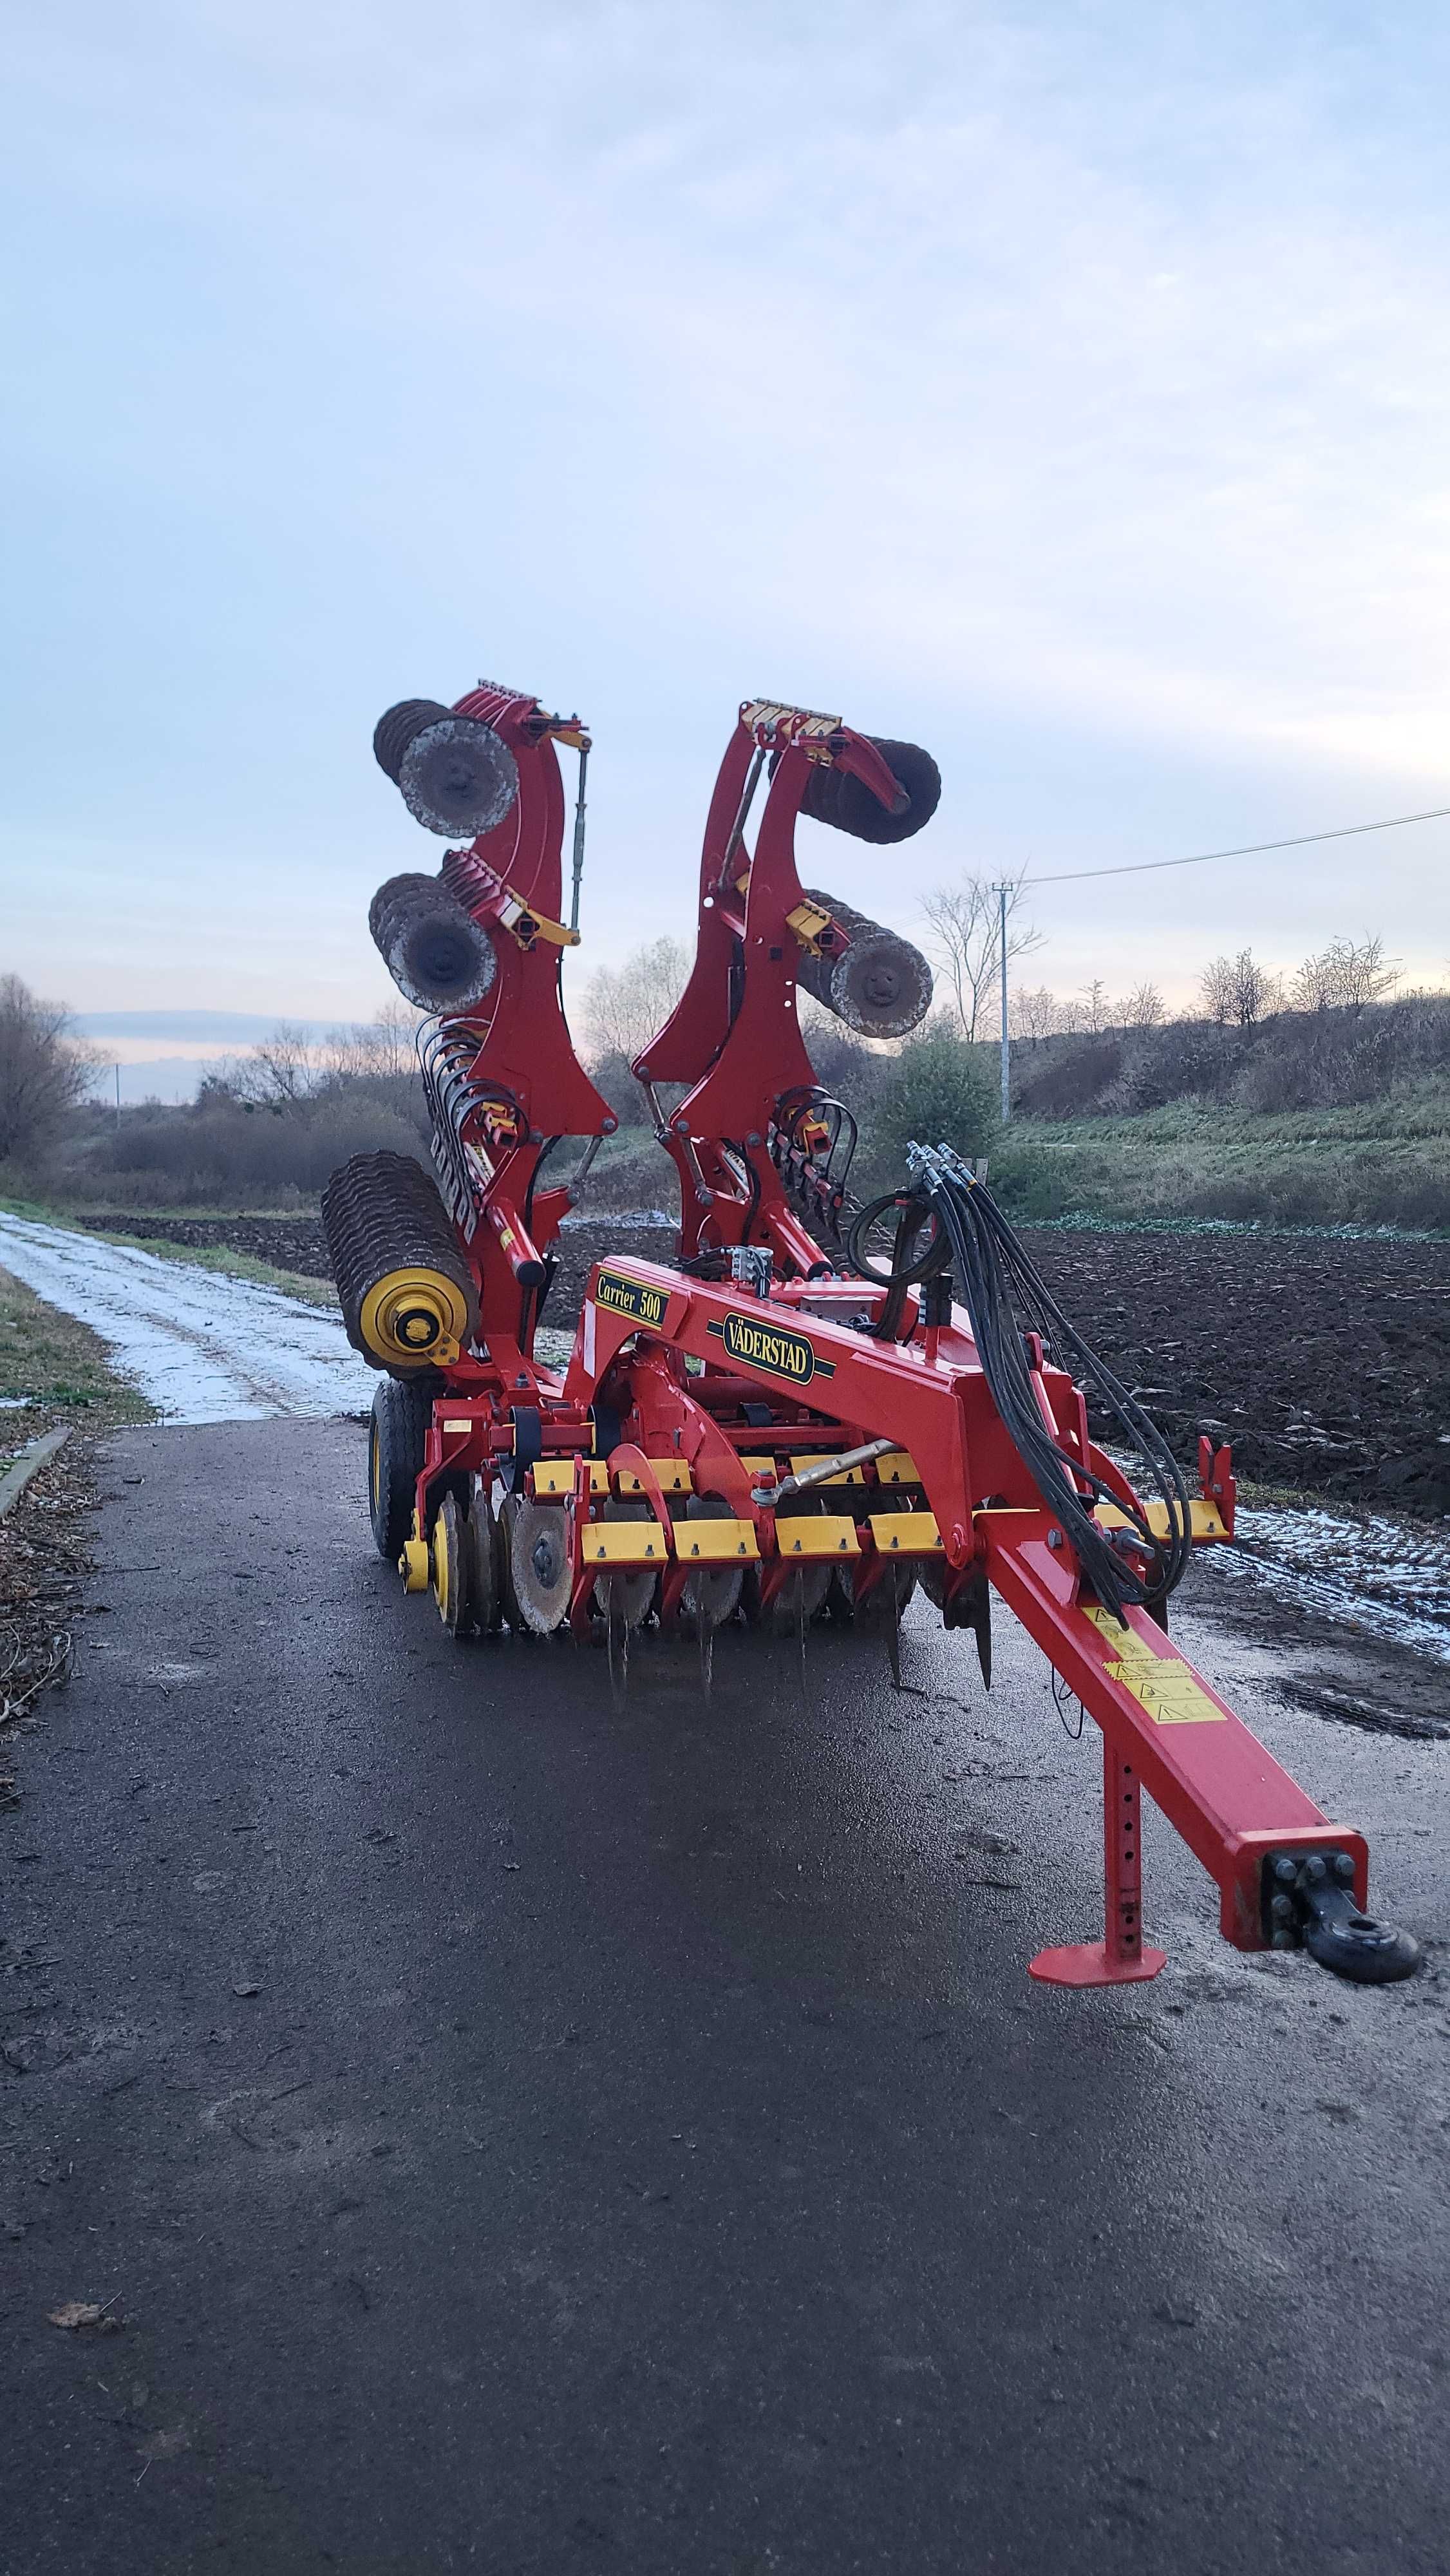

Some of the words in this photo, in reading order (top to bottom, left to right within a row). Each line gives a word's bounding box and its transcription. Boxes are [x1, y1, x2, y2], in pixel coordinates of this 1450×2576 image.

[598, 1276, 635, 1309] Carrier
[639, 1292, 660, 1320] 500
[729, 1319, 806, 1374] VÄDERSTAD
